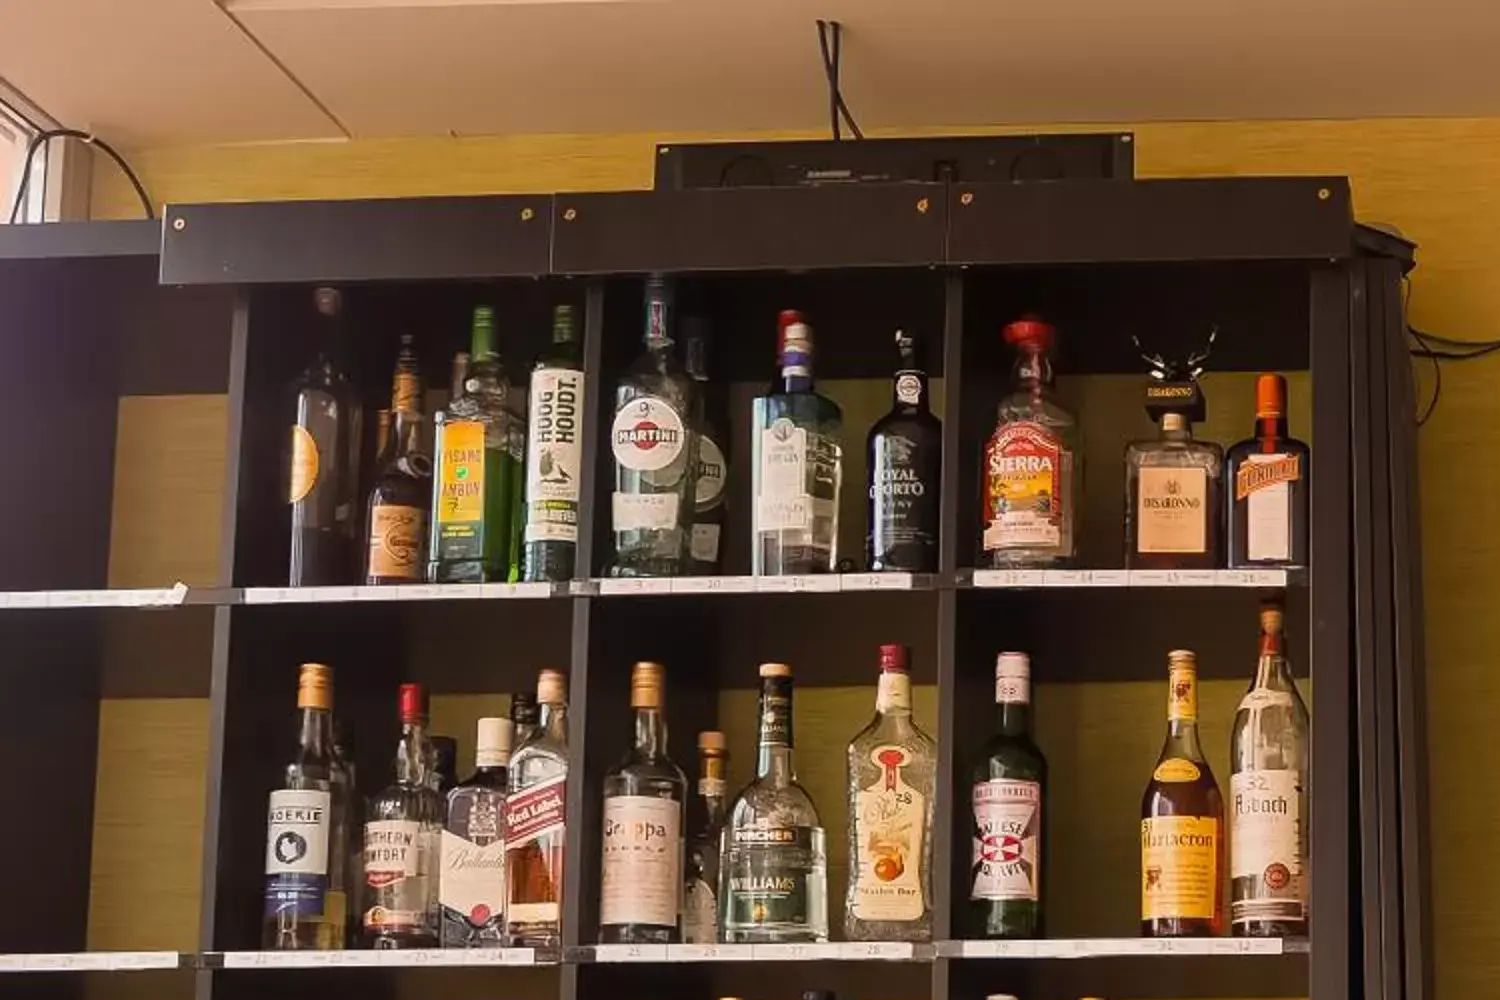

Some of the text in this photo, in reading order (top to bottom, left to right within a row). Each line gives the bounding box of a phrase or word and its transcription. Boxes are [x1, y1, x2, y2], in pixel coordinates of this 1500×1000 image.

[617, 429, 680, 445] MARTINI
[989, 455, 1053, 472] SIERRA
[882, 469, 918, 481] OYAL
[869, 481, 924, 498] OORTO
[606, 819, 666, 840] Grppa
